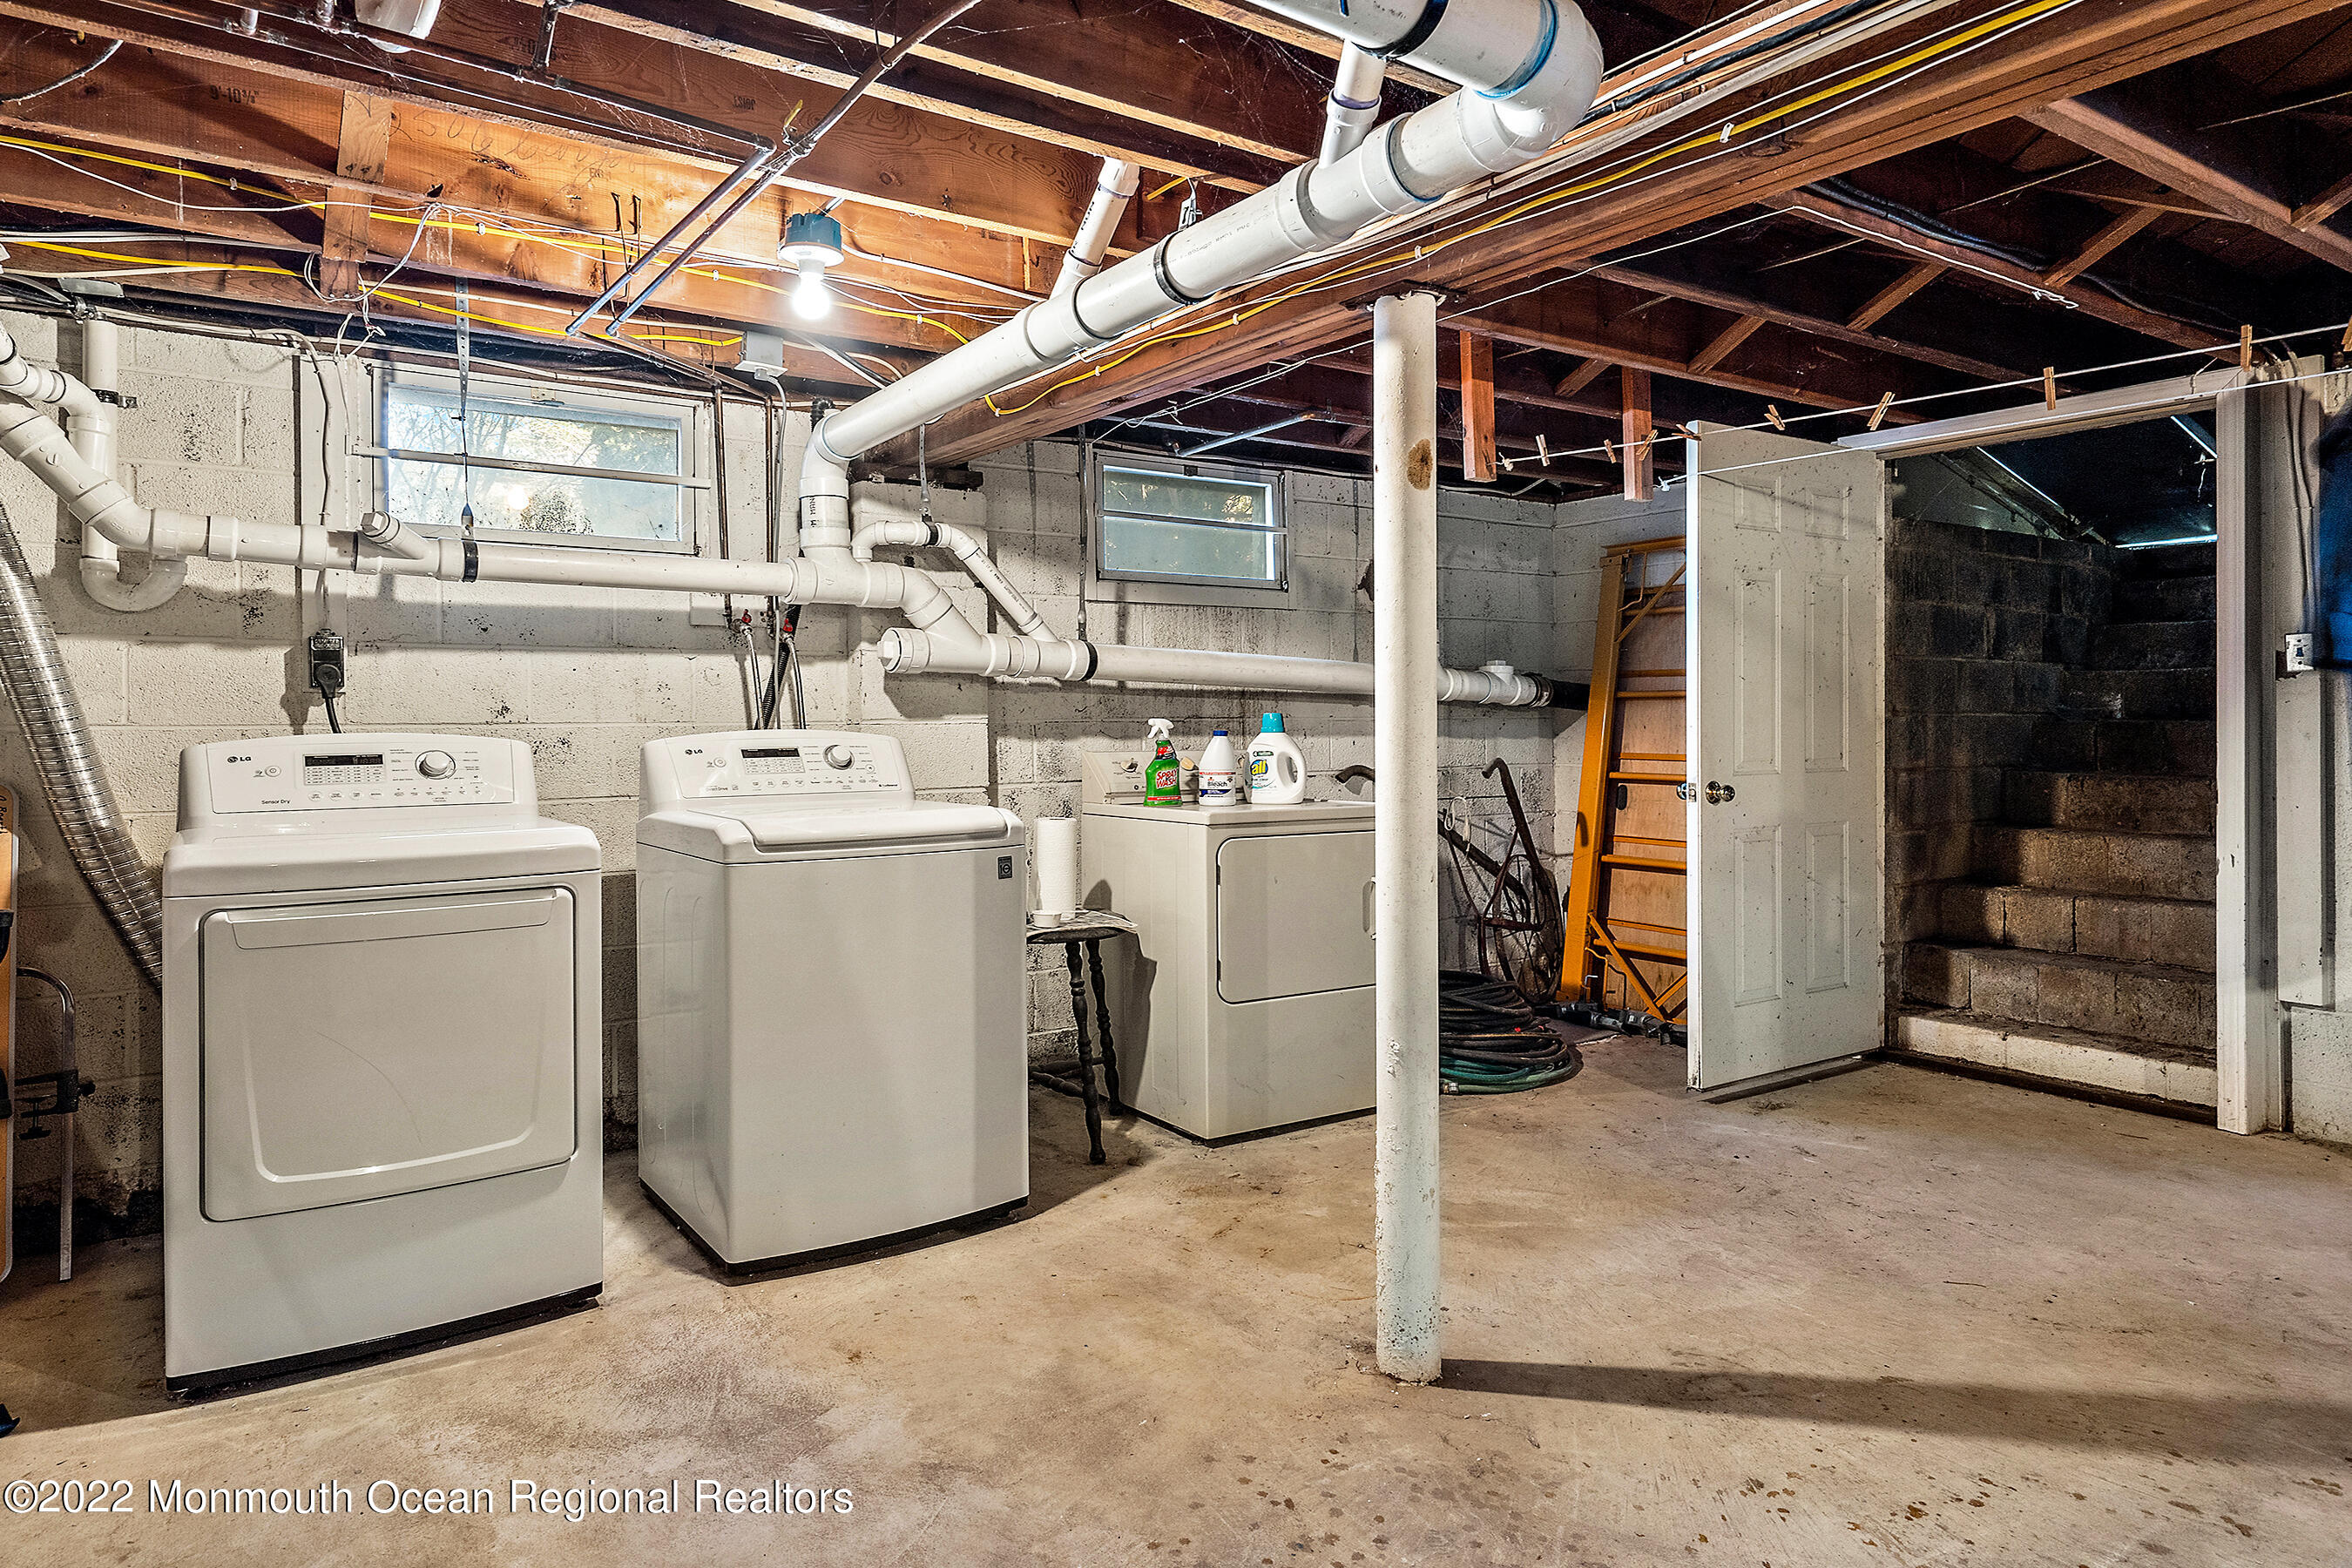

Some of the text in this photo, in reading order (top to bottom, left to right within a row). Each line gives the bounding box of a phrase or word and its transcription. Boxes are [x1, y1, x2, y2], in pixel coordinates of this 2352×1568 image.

[1252, 760, 1267, 774] all
[1157, 768, 1177, 781] SPRAY
[1157, 775, 1177, 787] WASH
